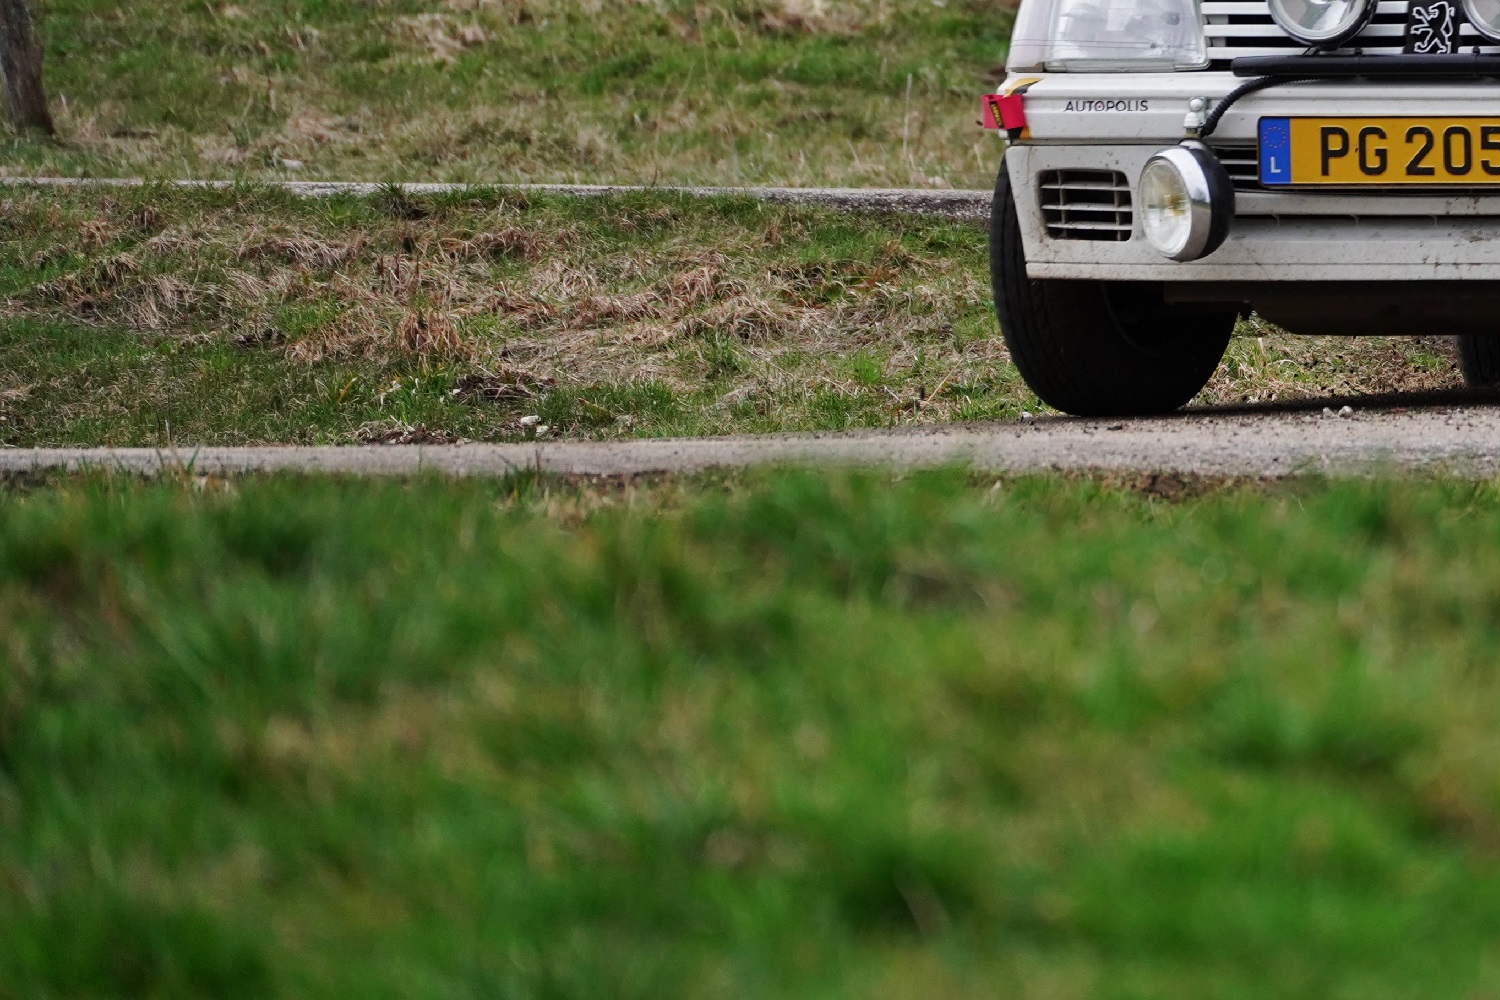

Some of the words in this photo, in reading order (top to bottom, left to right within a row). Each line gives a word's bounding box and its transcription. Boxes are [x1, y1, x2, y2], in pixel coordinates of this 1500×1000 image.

[1065, 99, 1149, 113] AUTOPOLIS
[1319, 126, 1388, 176] PG
[1270, 156, 1281, 173] L
